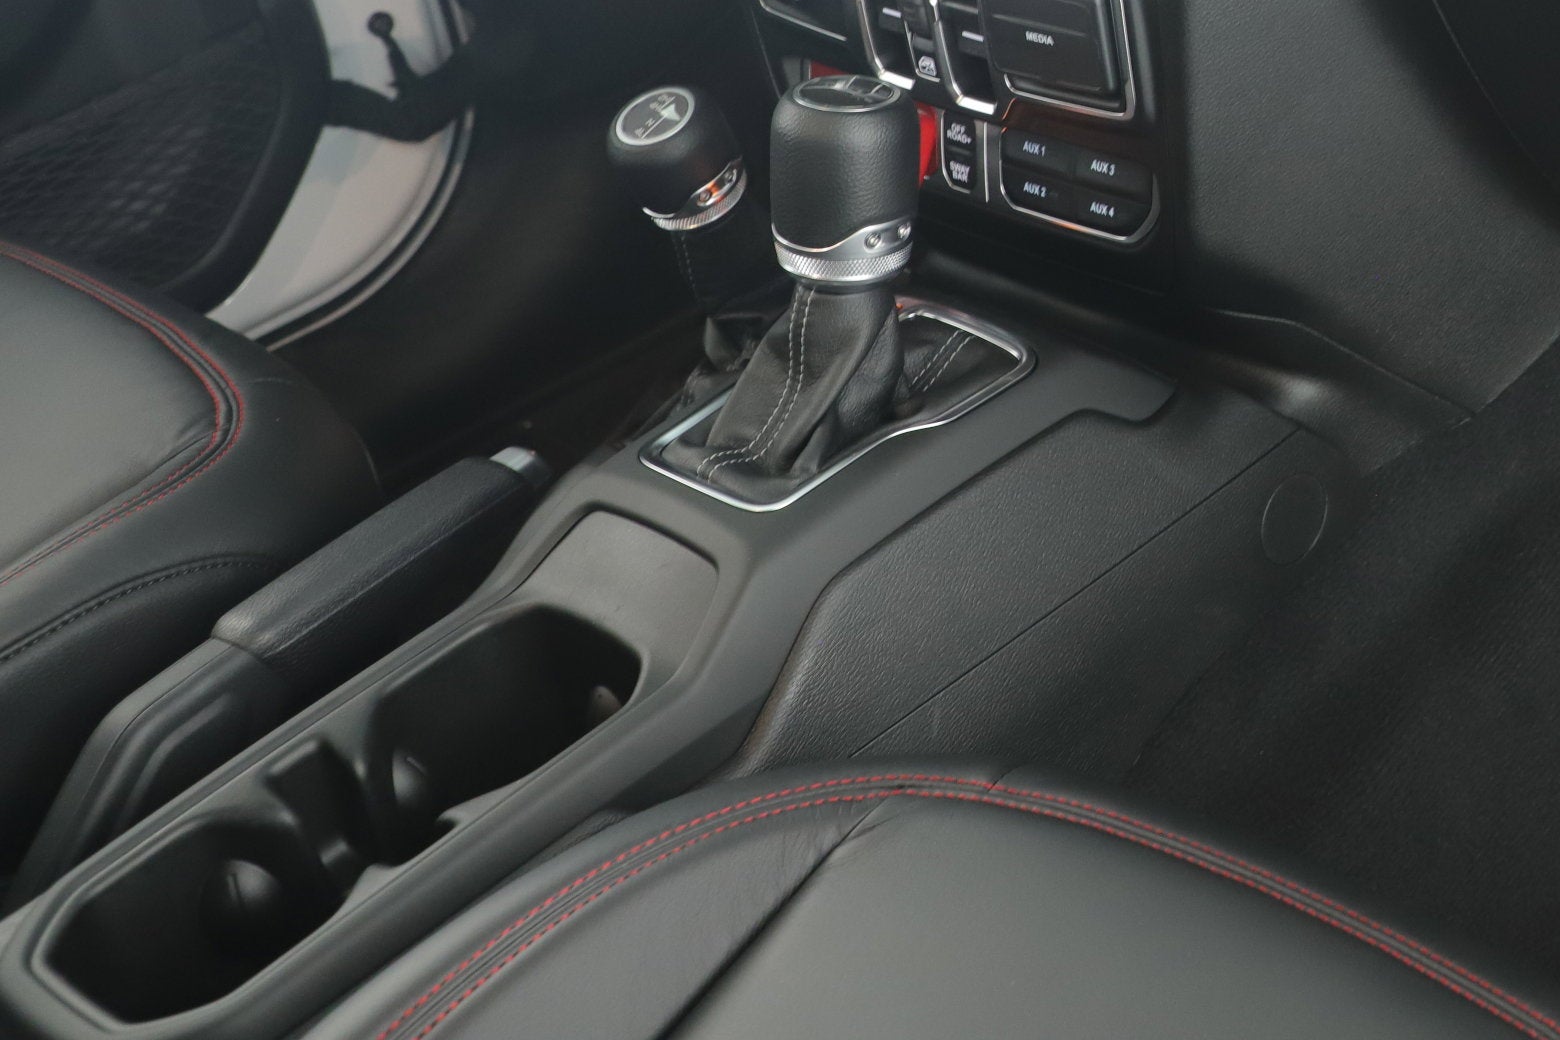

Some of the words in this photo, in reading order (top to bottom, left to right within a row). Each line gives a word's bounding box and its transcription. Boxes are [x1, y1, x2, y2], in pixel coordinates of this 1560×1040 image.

[1025, 30, 1055, 47] MEDIA
[951, 122, 967, 135] OFF
[1022, 140, 1041, 156] AUX
[1040, 145, 1047, 158] 1
[1090, 158, 1110, 175] AUX
[1108, 163, 1117, 177] 3
[1023, 181, 1040, 197] AUX
[1040, 186, 1048, 198] 2
[1089, 201, 1108, 217] AUX
[1107, 206, 1116, 218] 4
